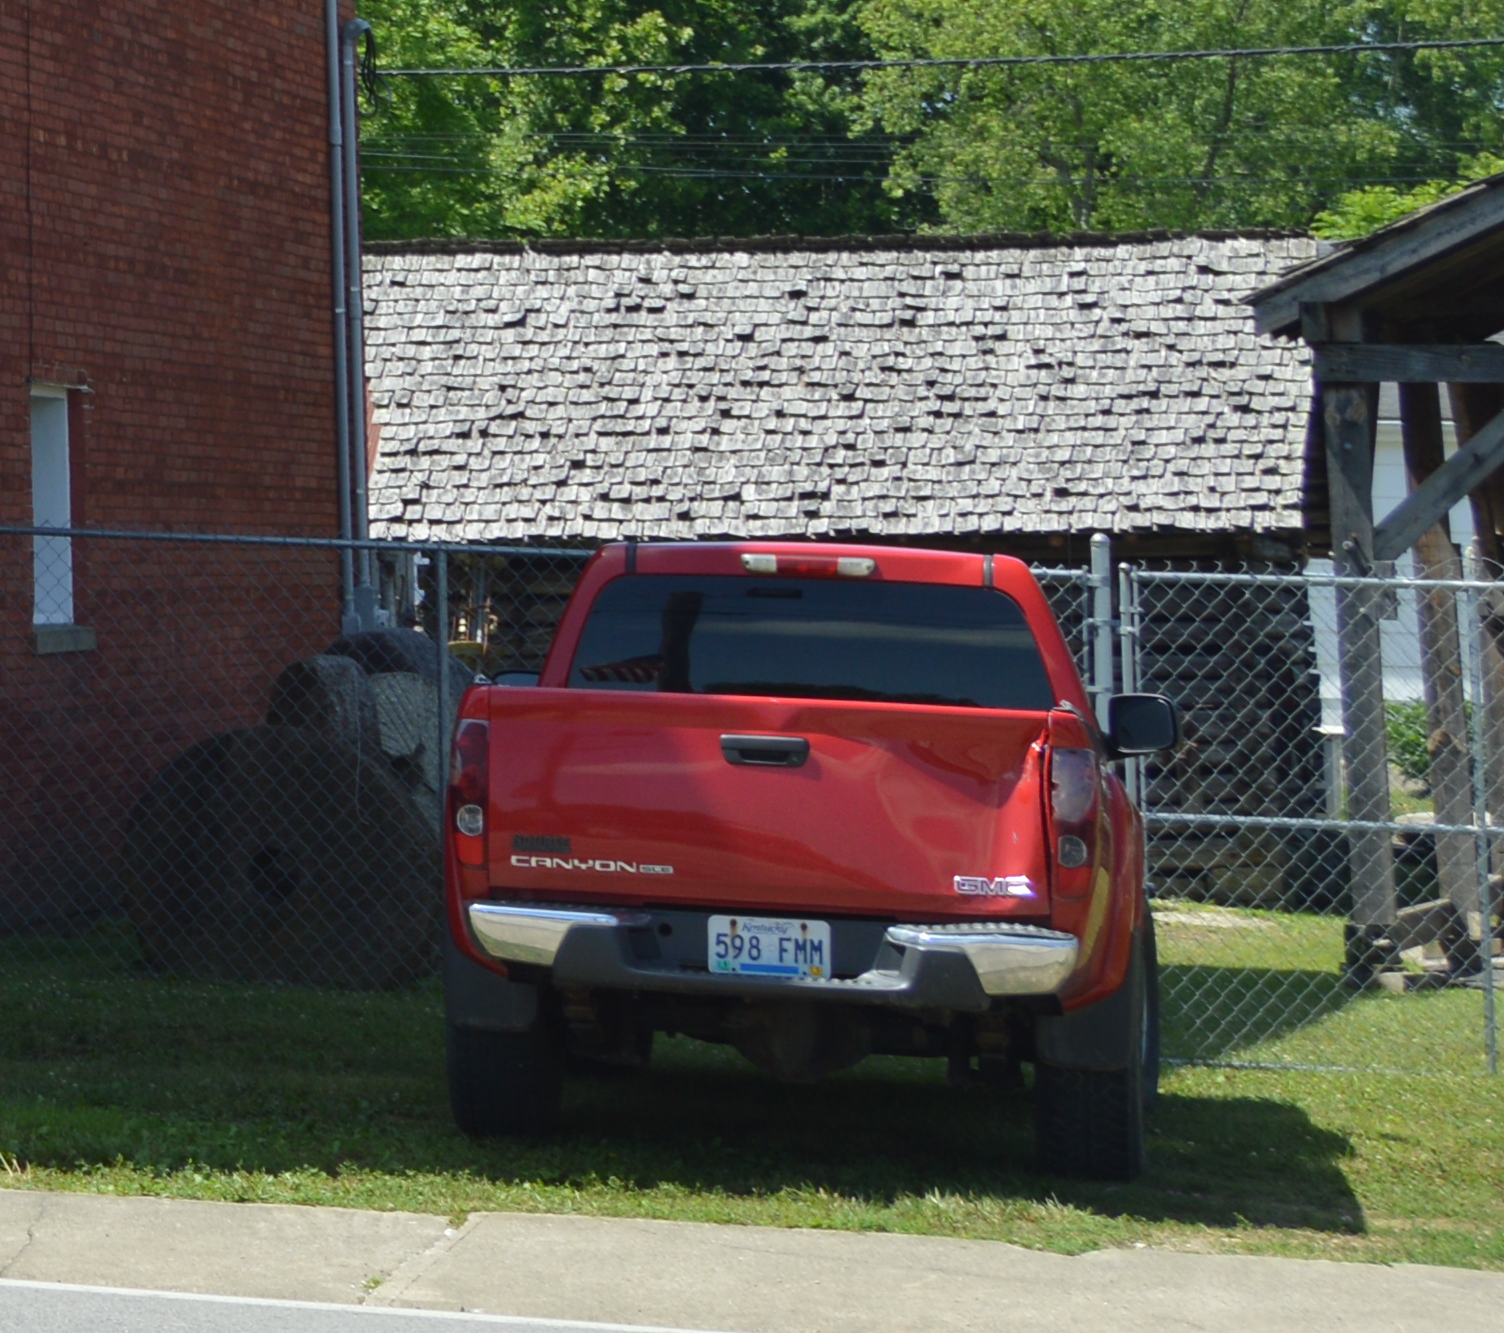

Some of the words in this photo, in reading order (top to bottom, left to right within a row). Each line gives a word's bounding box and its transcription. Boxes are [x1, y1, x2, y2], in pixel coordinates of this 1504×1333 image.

[510, 855, 637, 873] CANYON
[640, 865, 672, 874] SLE
[954, 875, 1032, 895] GMC
[741, 922, 788, 934] Kentucky
[715, 933, 761, 961] 598
[779, 937, 823, 964] FMM
